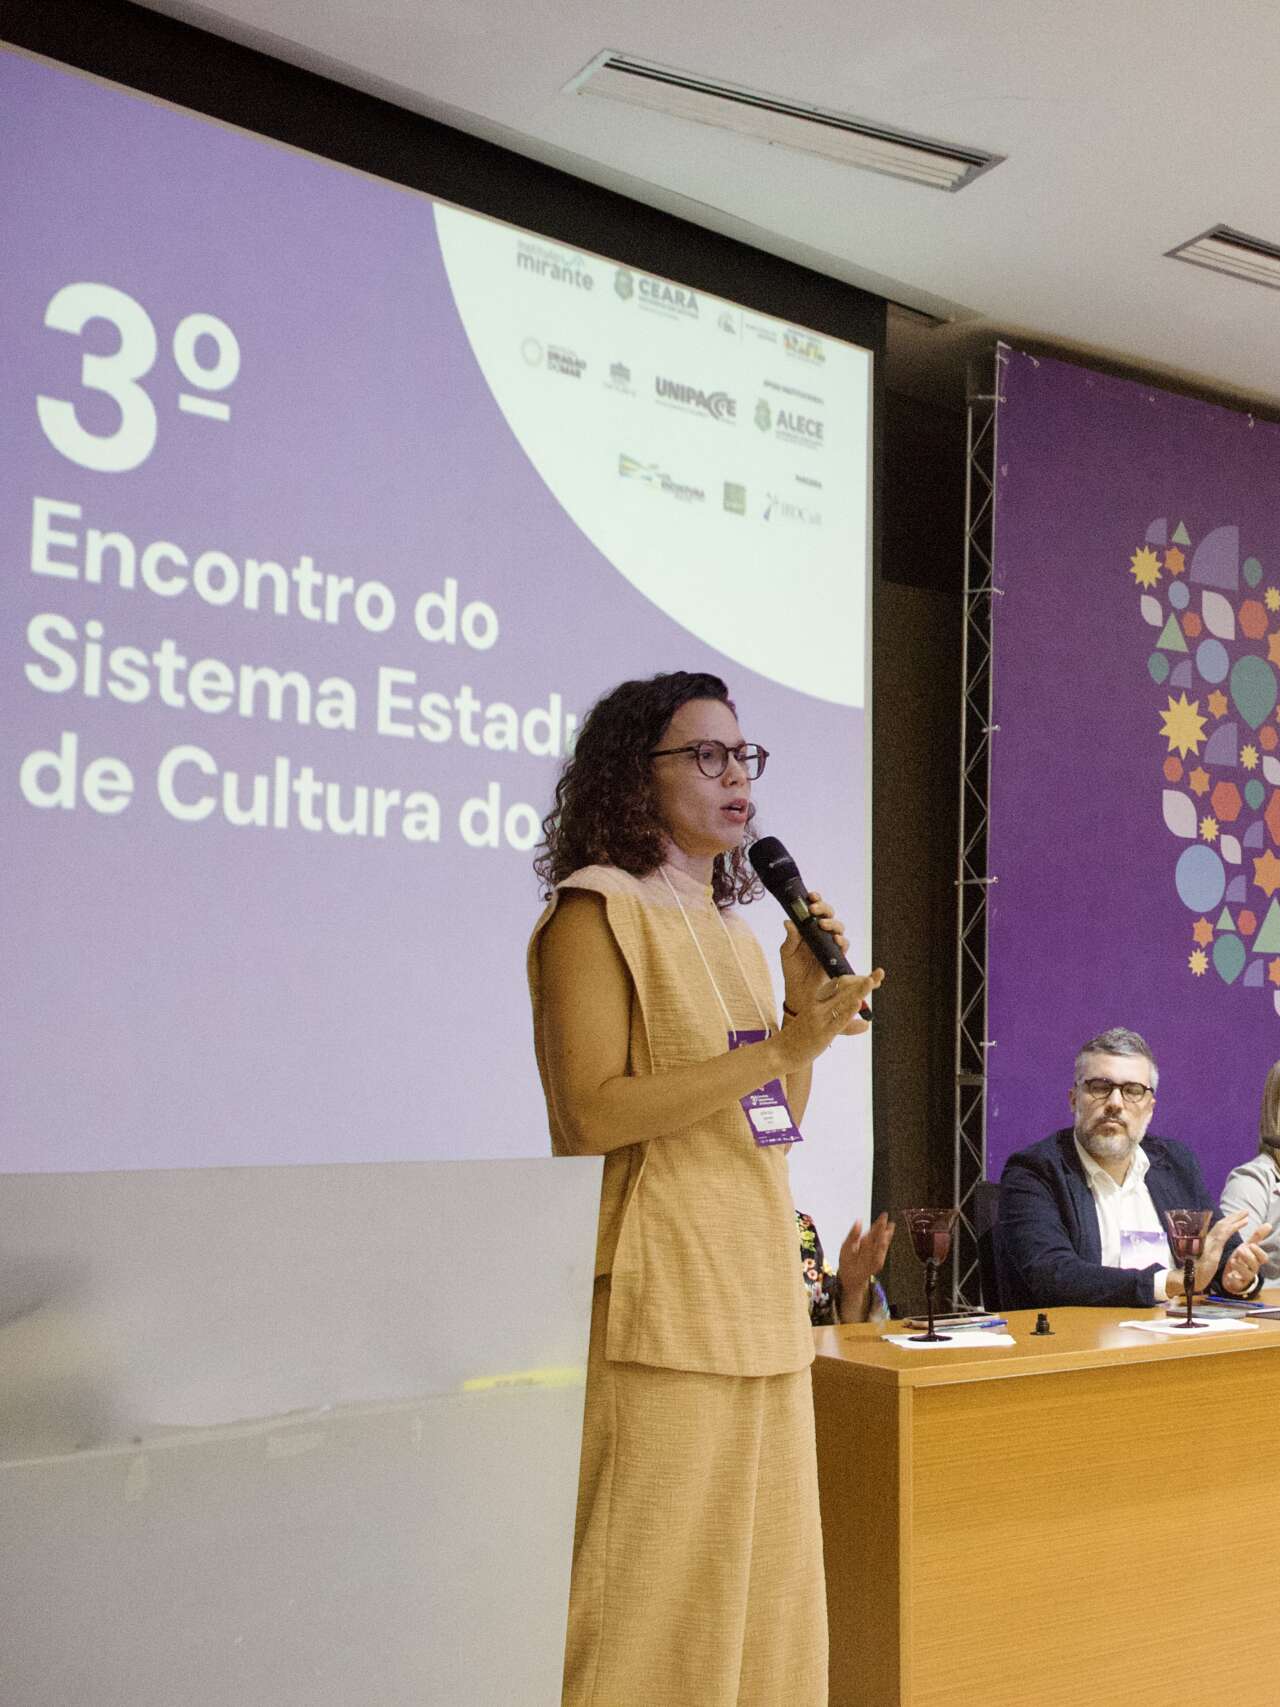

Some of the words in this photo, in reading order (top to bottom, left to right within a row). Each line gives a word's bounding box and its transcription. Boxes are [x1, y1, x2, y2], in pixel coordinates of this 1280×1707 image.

[516, 251, 595, 291] mirante
[37, 281, 241, 472] 3º
[776, 409, 825, 440] ALECE
[31, 496, 396, 632] Encontro
[414, 577, 499, 650] do
[24, 613, 356, 730] Sistema
[20, 731, 134, 814] de
[157, 744, 440, 842] Cultura
[458, 781, 541, 852] do
